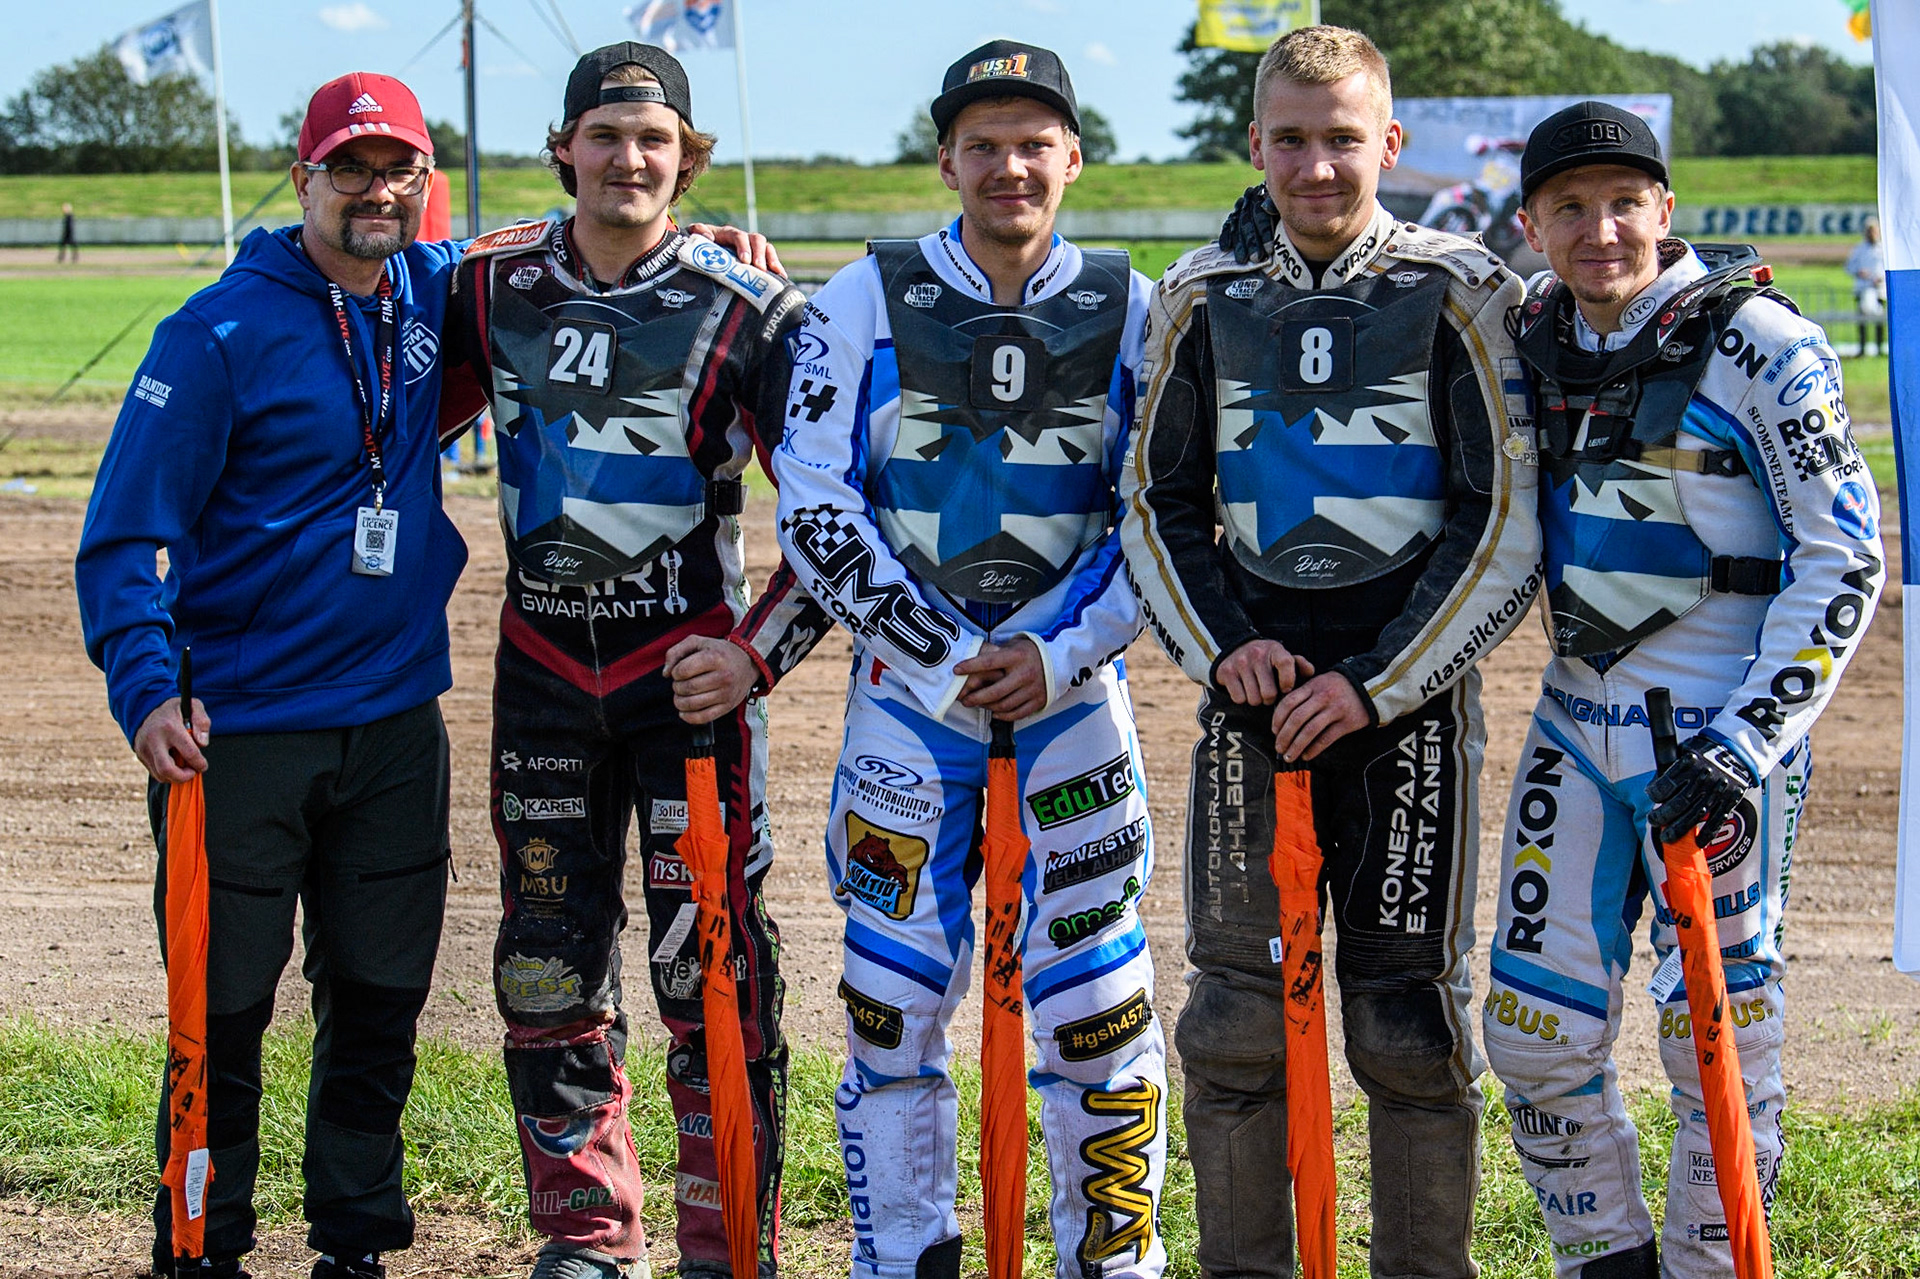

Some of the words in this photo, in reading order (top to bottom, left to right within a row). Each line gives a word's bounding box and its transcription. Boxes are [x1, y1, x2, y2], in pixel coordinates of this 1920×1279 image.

[348, 104, 383, 115] adidas
[1701, 208, 1803, 236] SPEED
[490, 226, 541, 247] HAWA
[1274, 234, 1302, 280] WACO
[1332, 235, 1377, 278] WACO
[728, 266, 770, 294] LNB
[909, 285, 936, 296] LONG
[1232, 281, 1258, 289] LONG
[1628, 300, 1651, 321] JYC
[548, 326, 610, 387] 24
[1299, 327, 1333, 384] 8
[804, 362, 832, 380] SML
[990, 344, 1026, 402] 9
[362, 520, 393, 530] LICENCE
[521, 592, 657, 621] GWARANT
[811, 577, 878, 645] STORE
[1735, 551, 1882, 743] ROXON
[527, 756, 583, 772] AFORTI
[526, 799, 584, 814] KAREN
[1226, 731, 1248, 872] AHLBOM
[1207, 711, 1226, 923] AUTOKORJAAMO
[1379, 730, 1419, 928] KONEPAJA
[1507, 746, 1564, 955] ROXON
[520, 873, 568, 896] MBU
[502, 974, 578, 998] BEST
[1071, 1002, 1144, 1049] #gsh457
